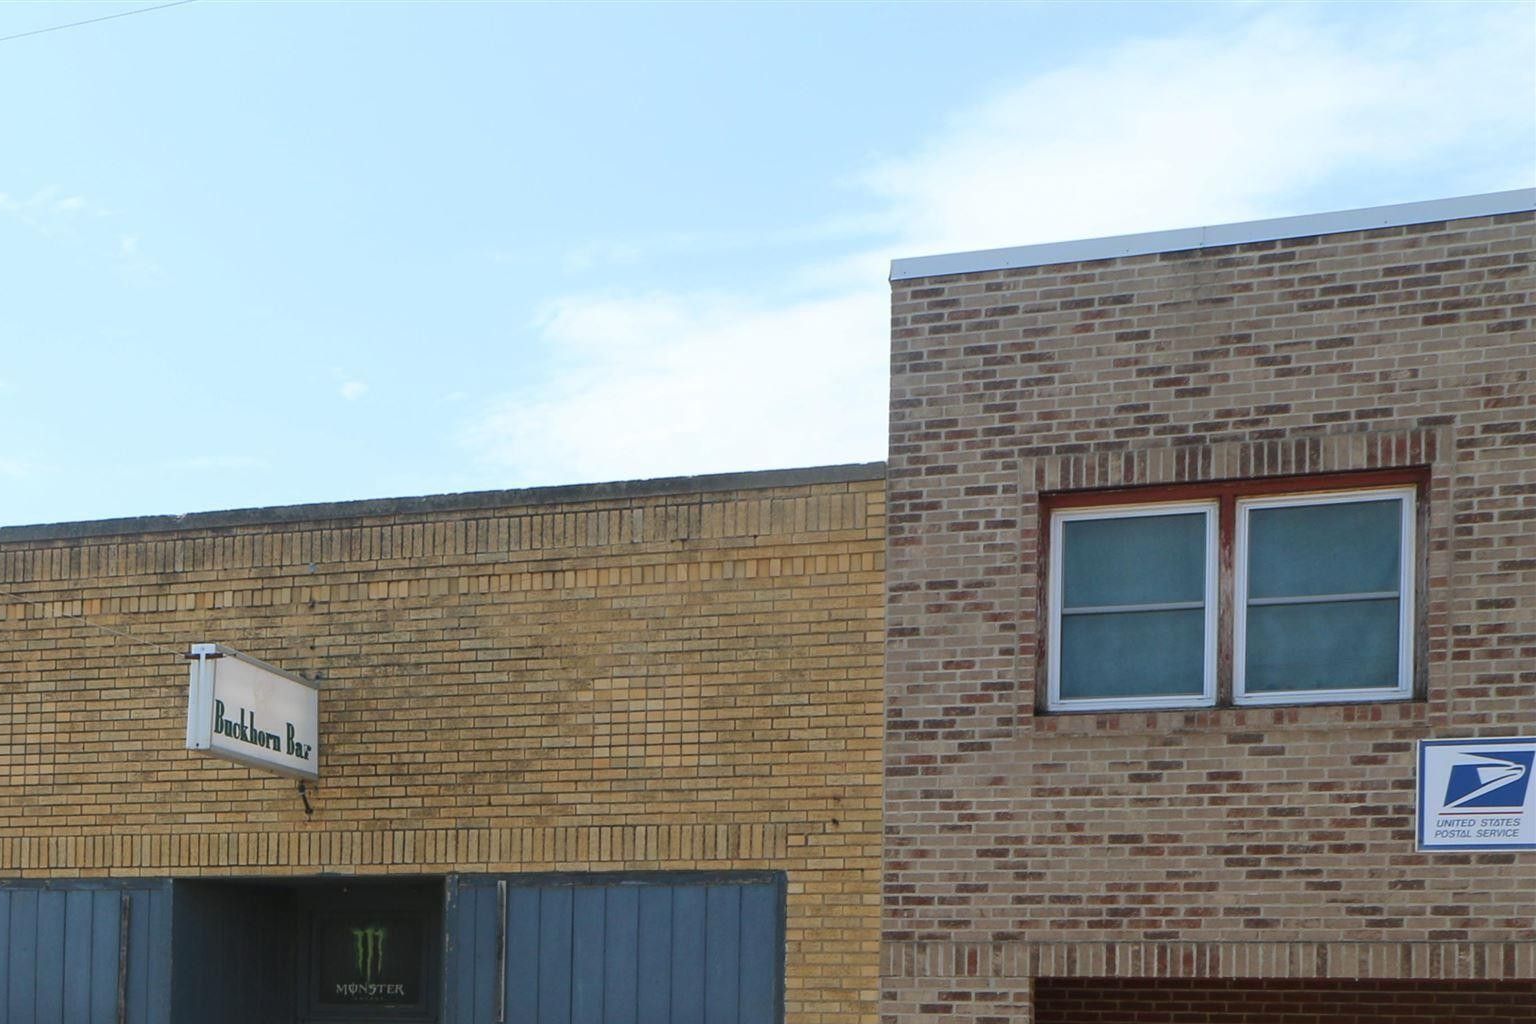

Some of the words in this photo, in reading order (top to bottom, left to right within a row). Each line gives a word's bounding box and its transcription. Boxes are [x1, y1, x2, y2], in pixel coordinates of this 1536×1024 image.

[214, 699, 282, 753] Buckhorn
[285, 722, 312, 760] Bar
[1436, 818, 1476, 828] UNITED
[1480, 818, 1521, 828] STATES
[1434, 829, 1472, 839] POSTAL
[1476, 828, 1520, 838] SERVICE
[336, 982, 405, 996] MONSTER
